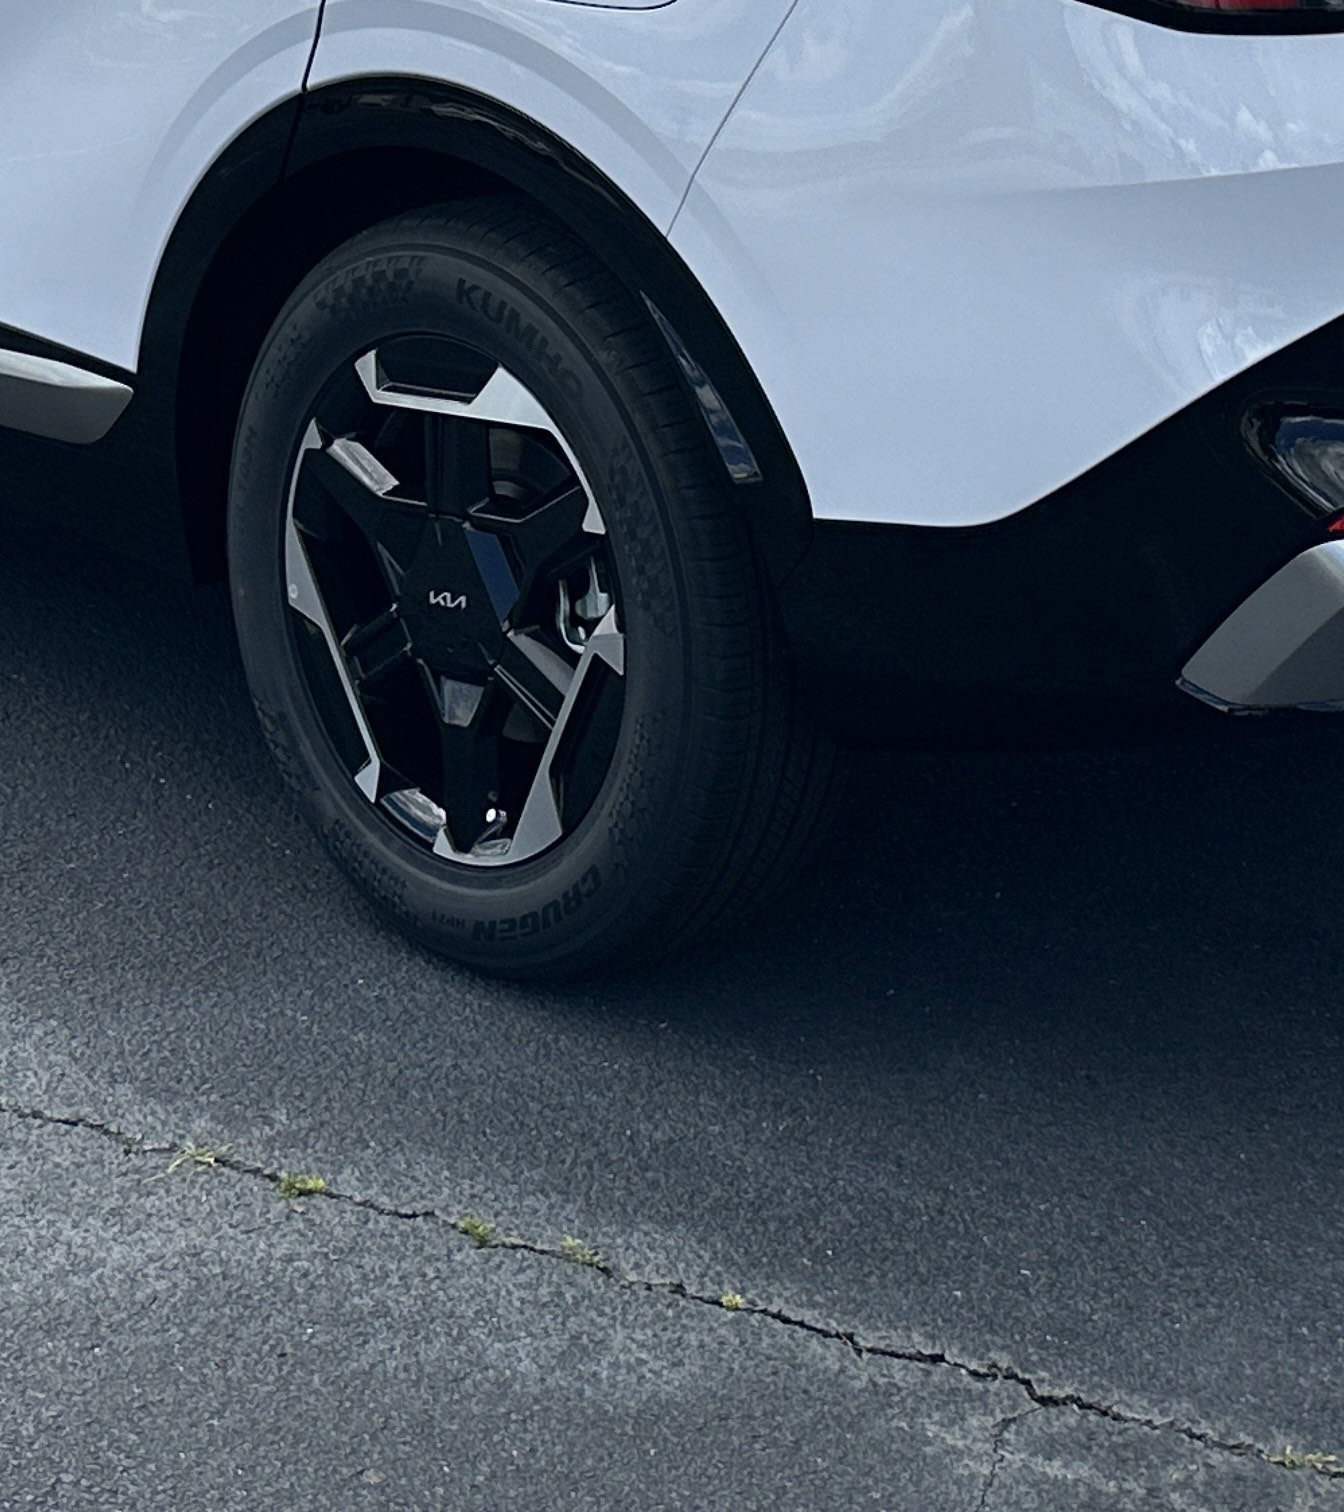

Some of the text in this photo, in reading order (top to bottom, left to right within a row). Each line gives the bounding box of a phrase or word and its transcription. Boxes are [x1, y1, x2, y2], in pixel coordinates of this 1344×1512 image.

[456, 278, 583, 397] KUMHO
[429, 590, 467, 609] KIA
[471, 863, 603, 945] CRUGEN
